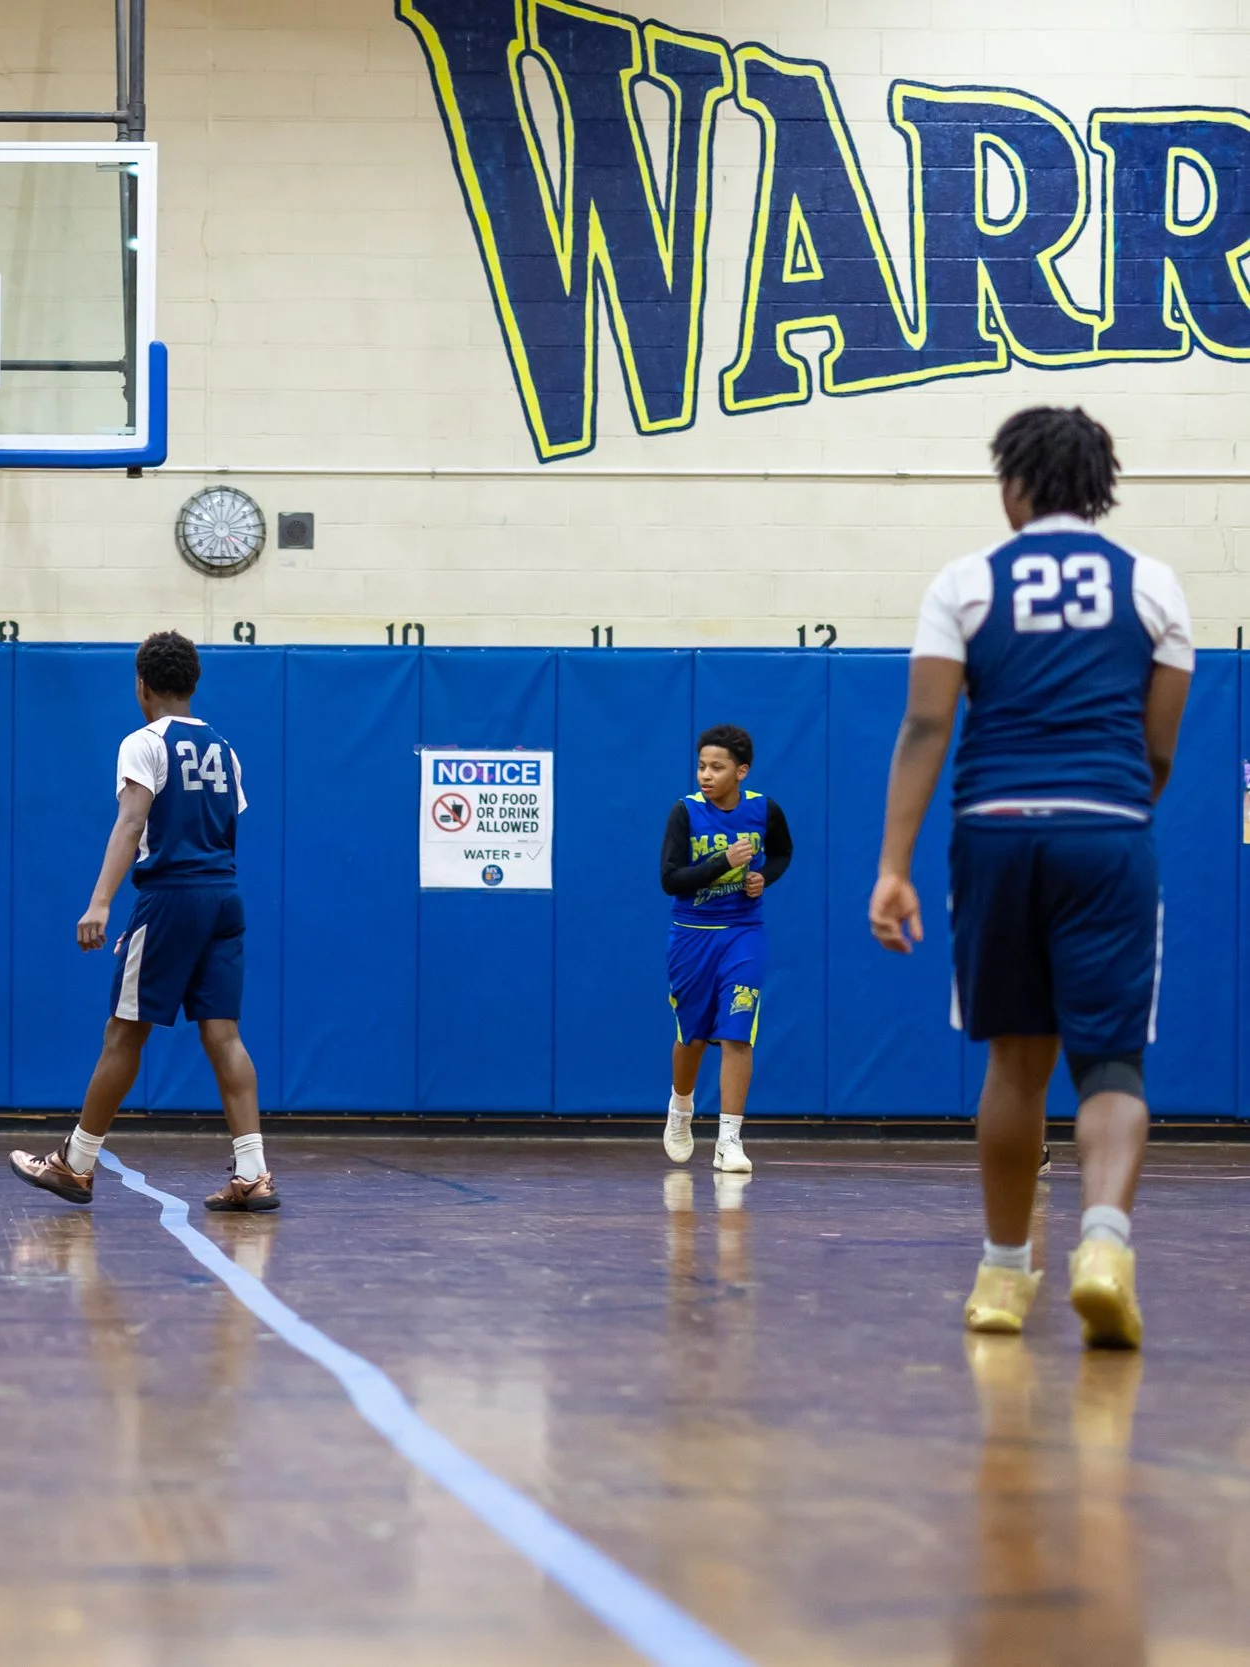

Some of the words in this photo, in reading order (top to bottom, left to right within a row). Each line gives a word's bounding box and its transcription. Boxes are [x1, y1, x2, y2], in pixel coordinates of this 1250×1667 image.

[1012, 553, 1114, 633] 23
[233, 621, 256, 645] 9
[385, 622, 425, 646] 10
[590, 624, 613, 648] 11
[796, 624, 837, 648] 12
[175, 740, 229, 793] 24
[438, 762, 538, 784] NOTICE
[478, 793, 498, 805] NO
[502, 793, 538, 805] FOOD
[476, 807, 494, 819] OR
[499, 807, 540, 820] DRINK
[476, 821, 539, 833] ALLOWED
[463, 849, 511, 860] WATER
